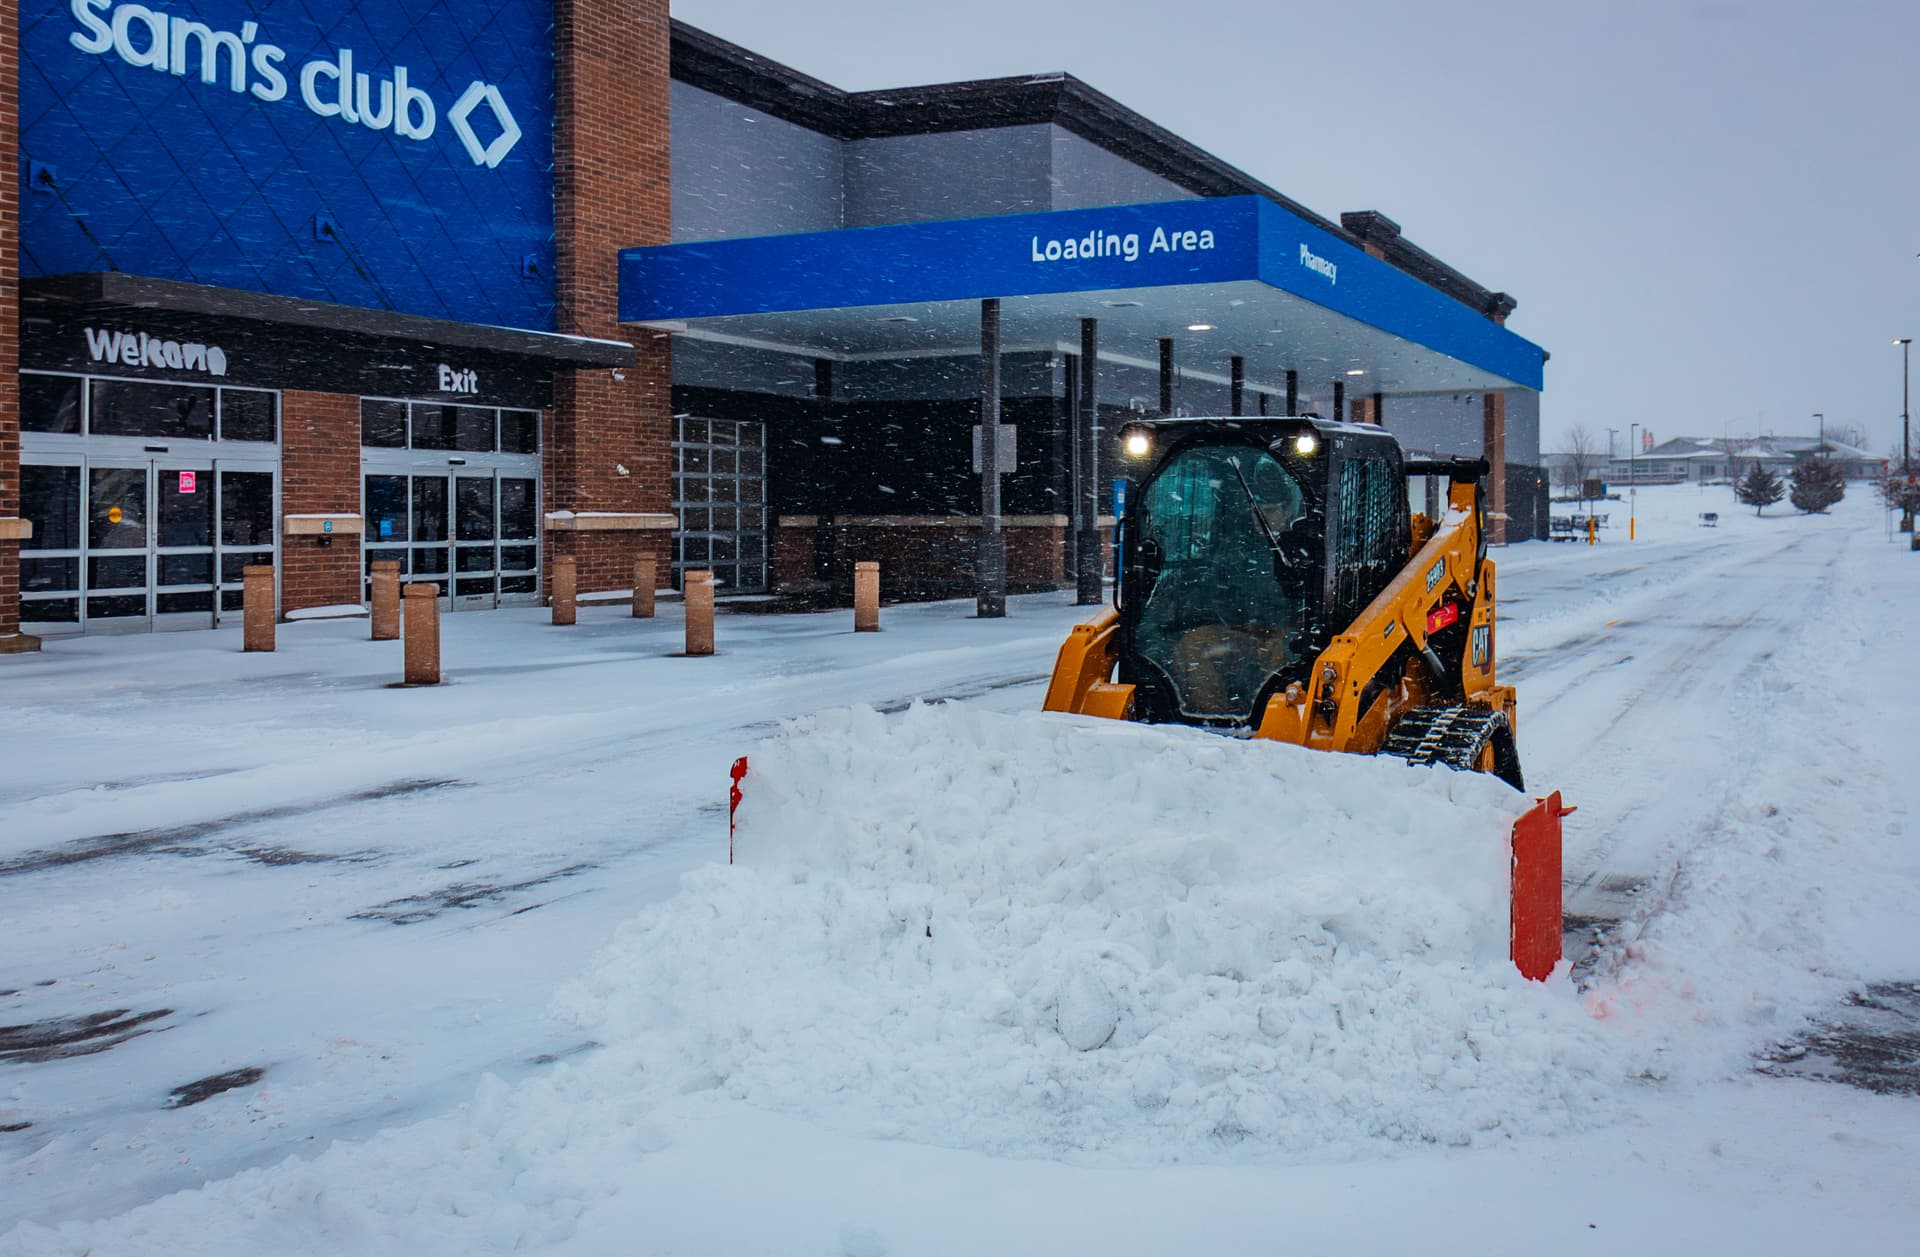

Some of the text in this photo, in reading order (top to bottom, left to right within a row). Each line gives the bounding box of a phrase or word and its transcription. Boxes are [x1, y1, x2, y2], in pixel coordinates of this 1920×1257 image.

[69, 0, 436, 140] sam's club
[1032, 226, 1215, 262] Loading Area
[1299, 242, 1337, 286] Pharmacy
[438, 363, 479, 394] Exit
[1472, 626, 1489, 667] CAT
